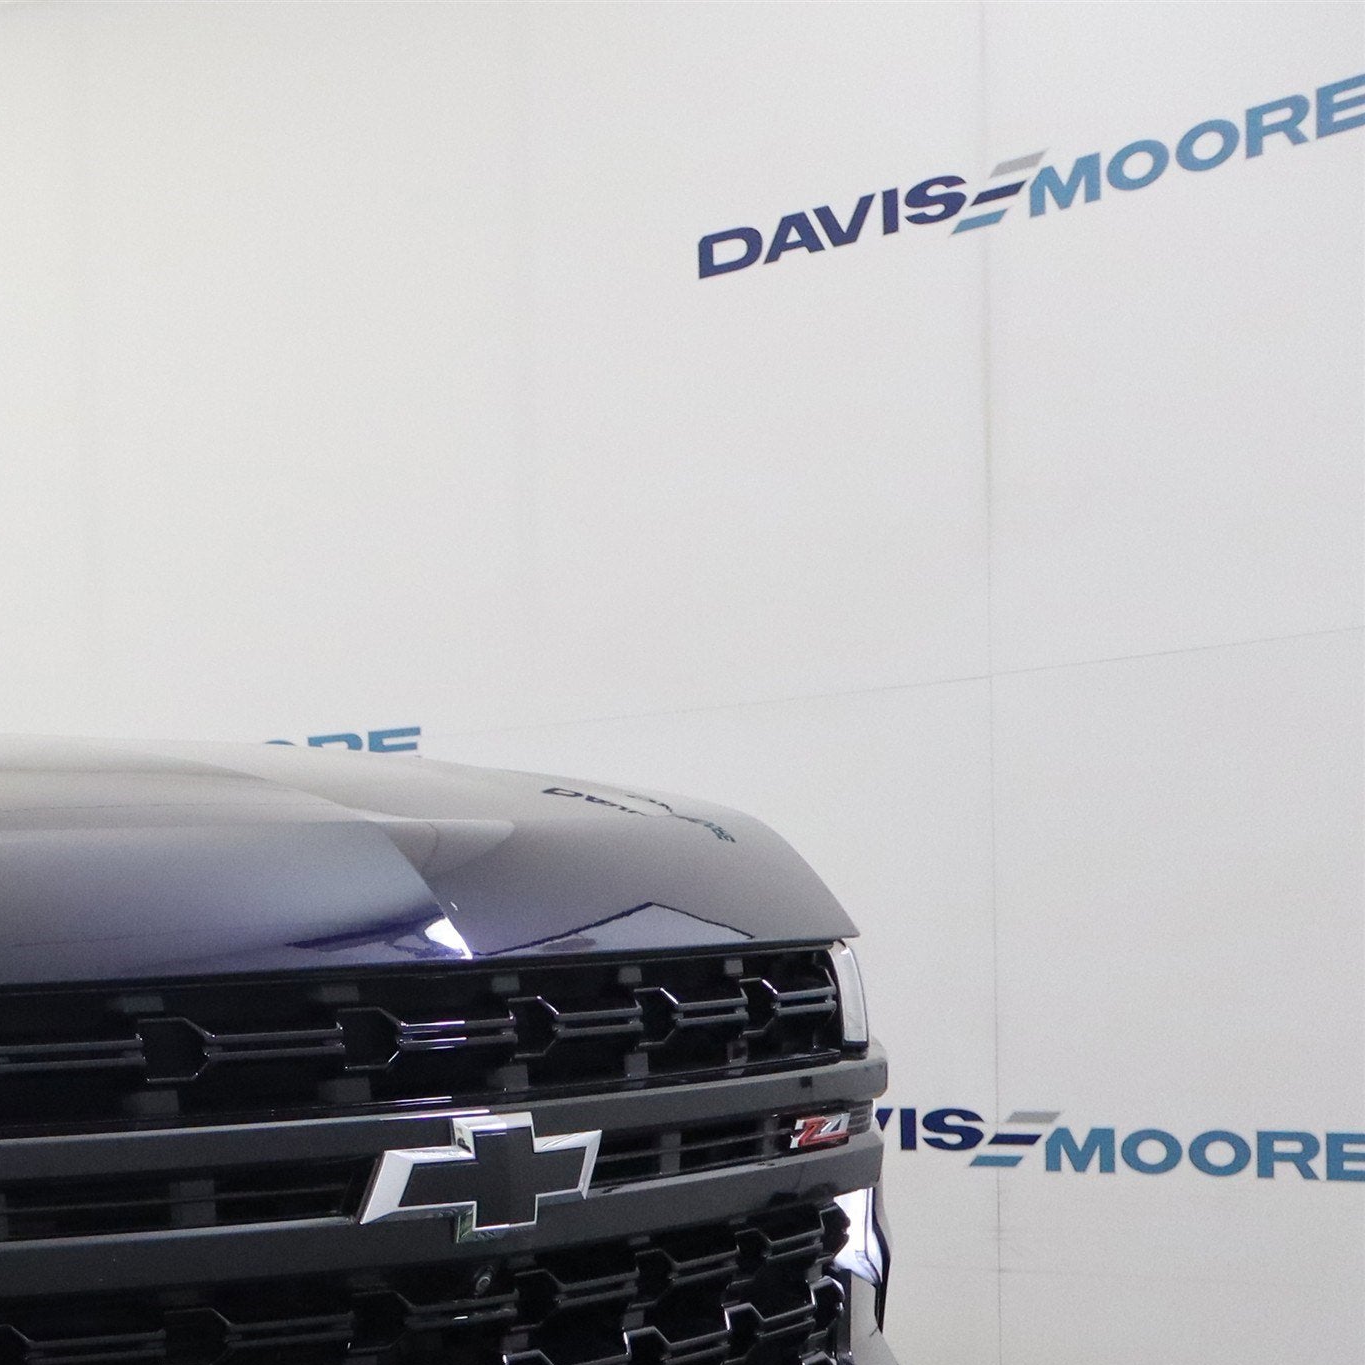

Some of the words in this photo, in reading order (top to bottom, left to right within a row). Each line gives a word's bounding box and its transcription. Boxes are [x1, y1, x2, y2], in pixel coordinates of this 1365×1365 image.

[698, 175, 968, 279] DAVIS
[1030, 73, 1365, 218] MOORE
[1045, 1125, 1365, 1183] MOORE
